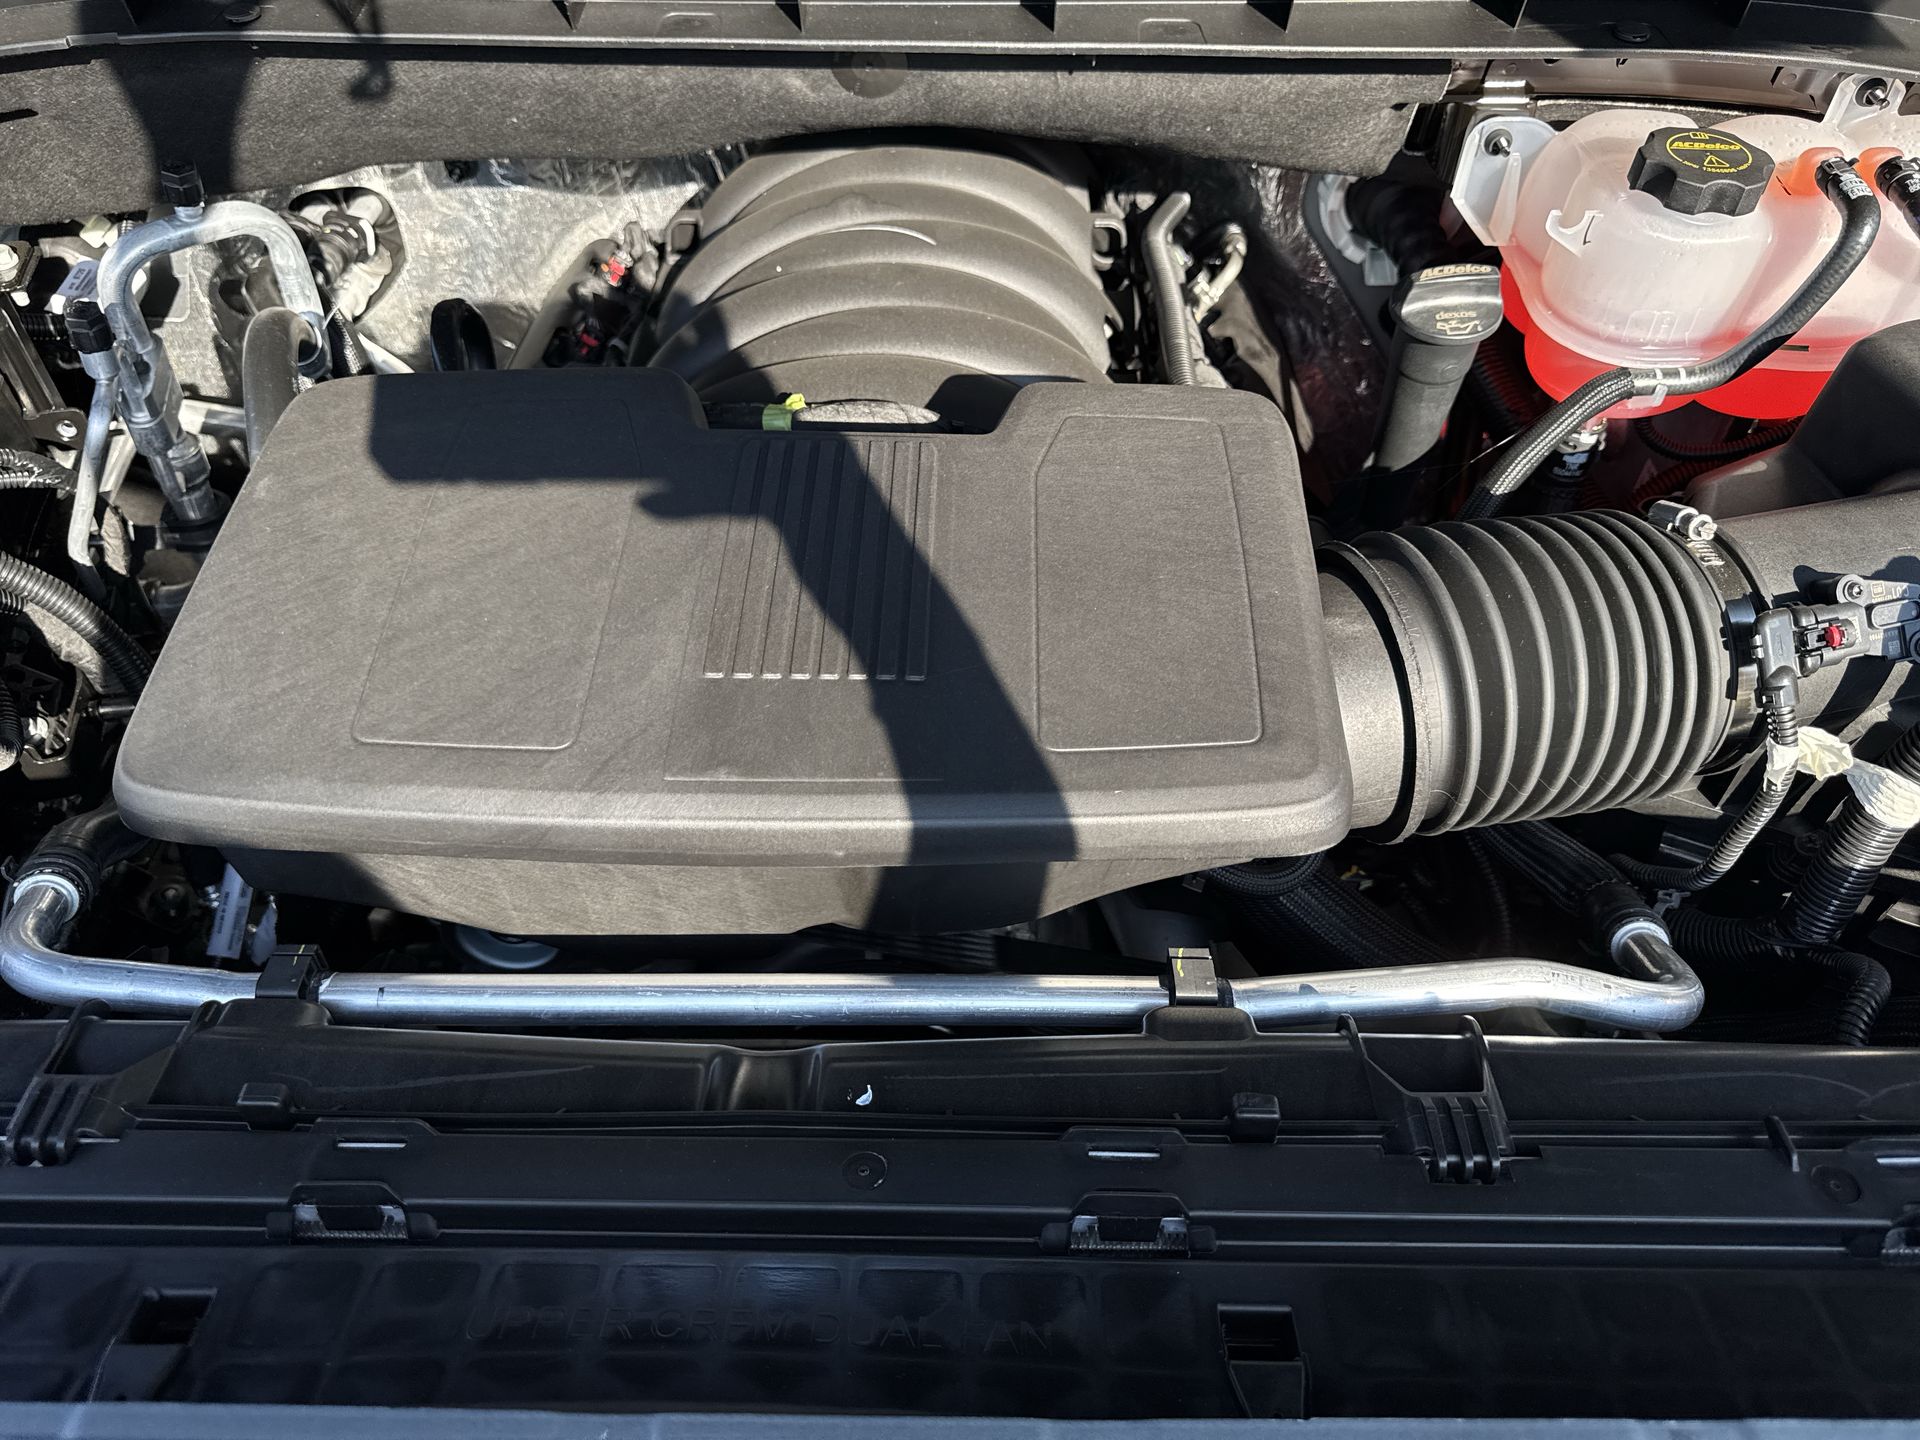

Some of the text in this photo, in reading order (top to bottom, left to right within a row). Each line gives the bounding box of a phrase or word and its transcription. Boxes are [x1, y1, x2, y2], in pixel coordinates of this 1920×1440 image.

[1670, 141, 1741, 150] ACDelco
[1420, 264, 1491, 281] ACDelco
[1435, 311, 1477, 321] dexos
[465, 1305, 633, 1341] UPPER
[812, 1313, 942, 1348] DUAL
[958, 1317, 1053, 1353] FAN
